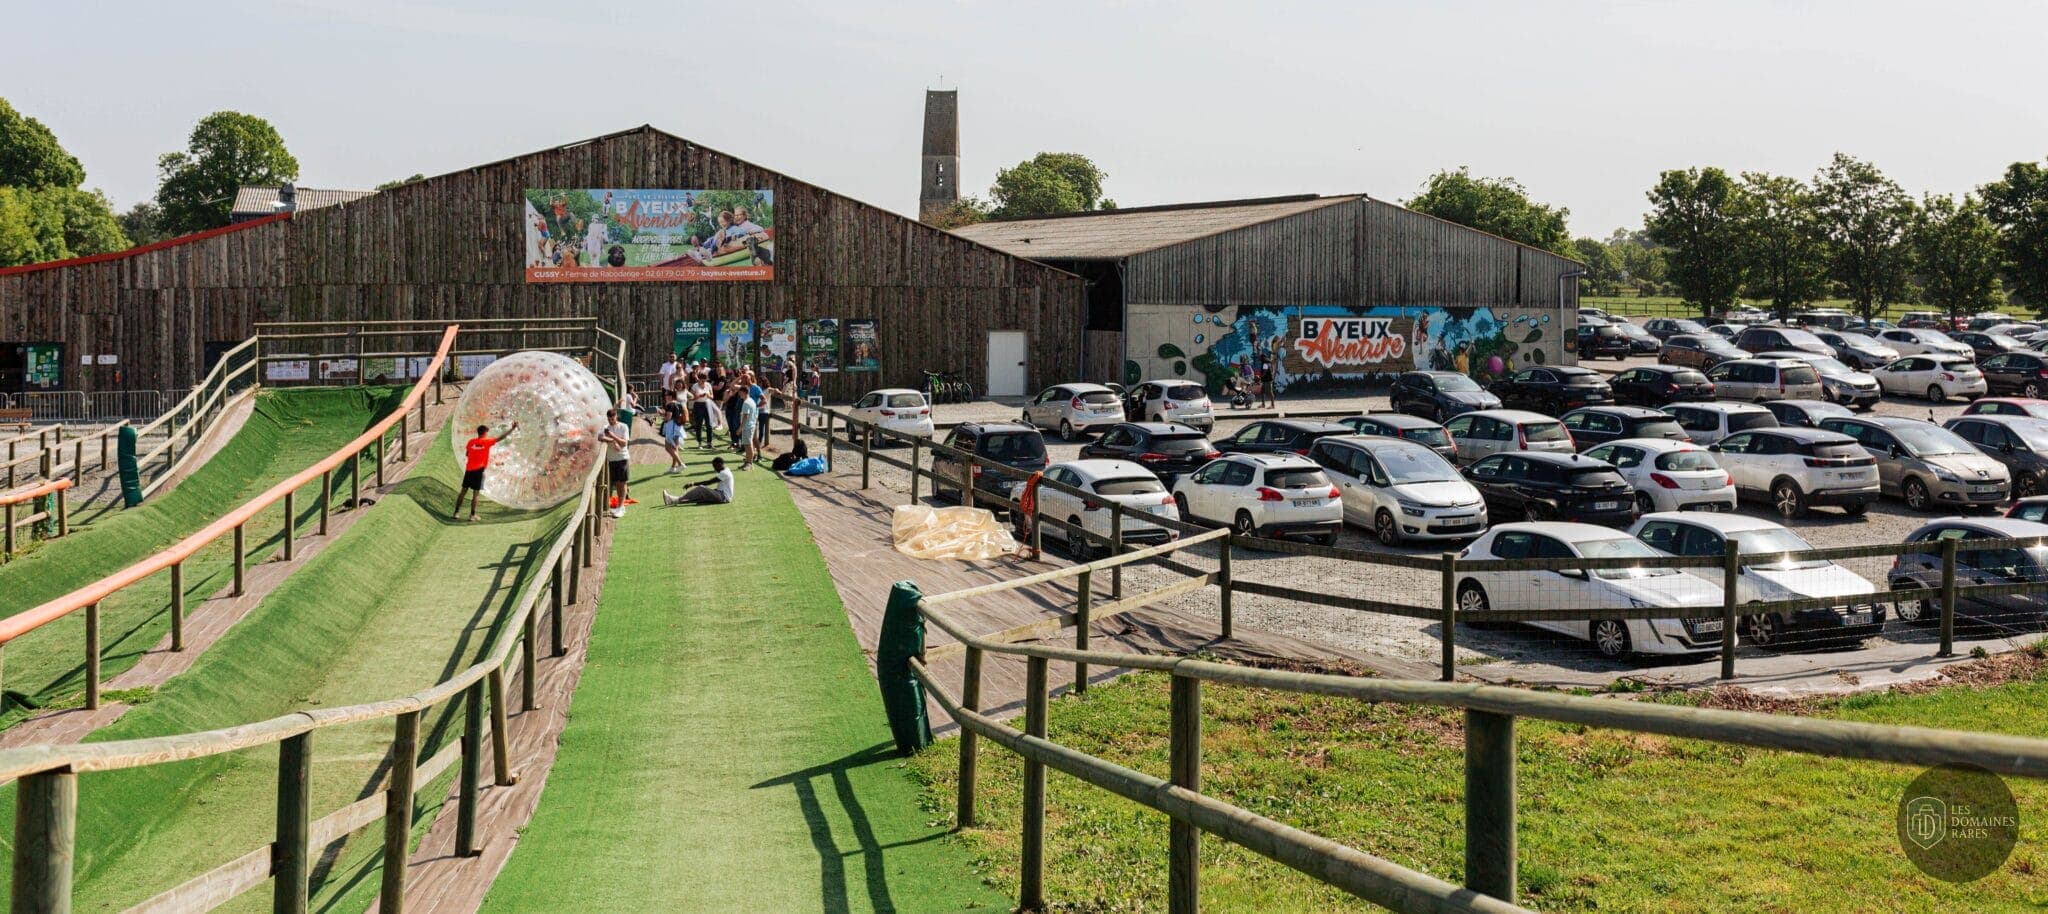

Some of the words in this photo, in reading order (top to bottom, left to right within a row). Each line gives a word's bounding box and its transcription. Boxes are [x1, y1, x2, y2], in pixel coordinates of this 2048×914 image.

[720, 320, 749, 331] ZOO
[1304, 320, 1389, 339] BAYEUX
[1299, 319, 1404, 363] Aventure
